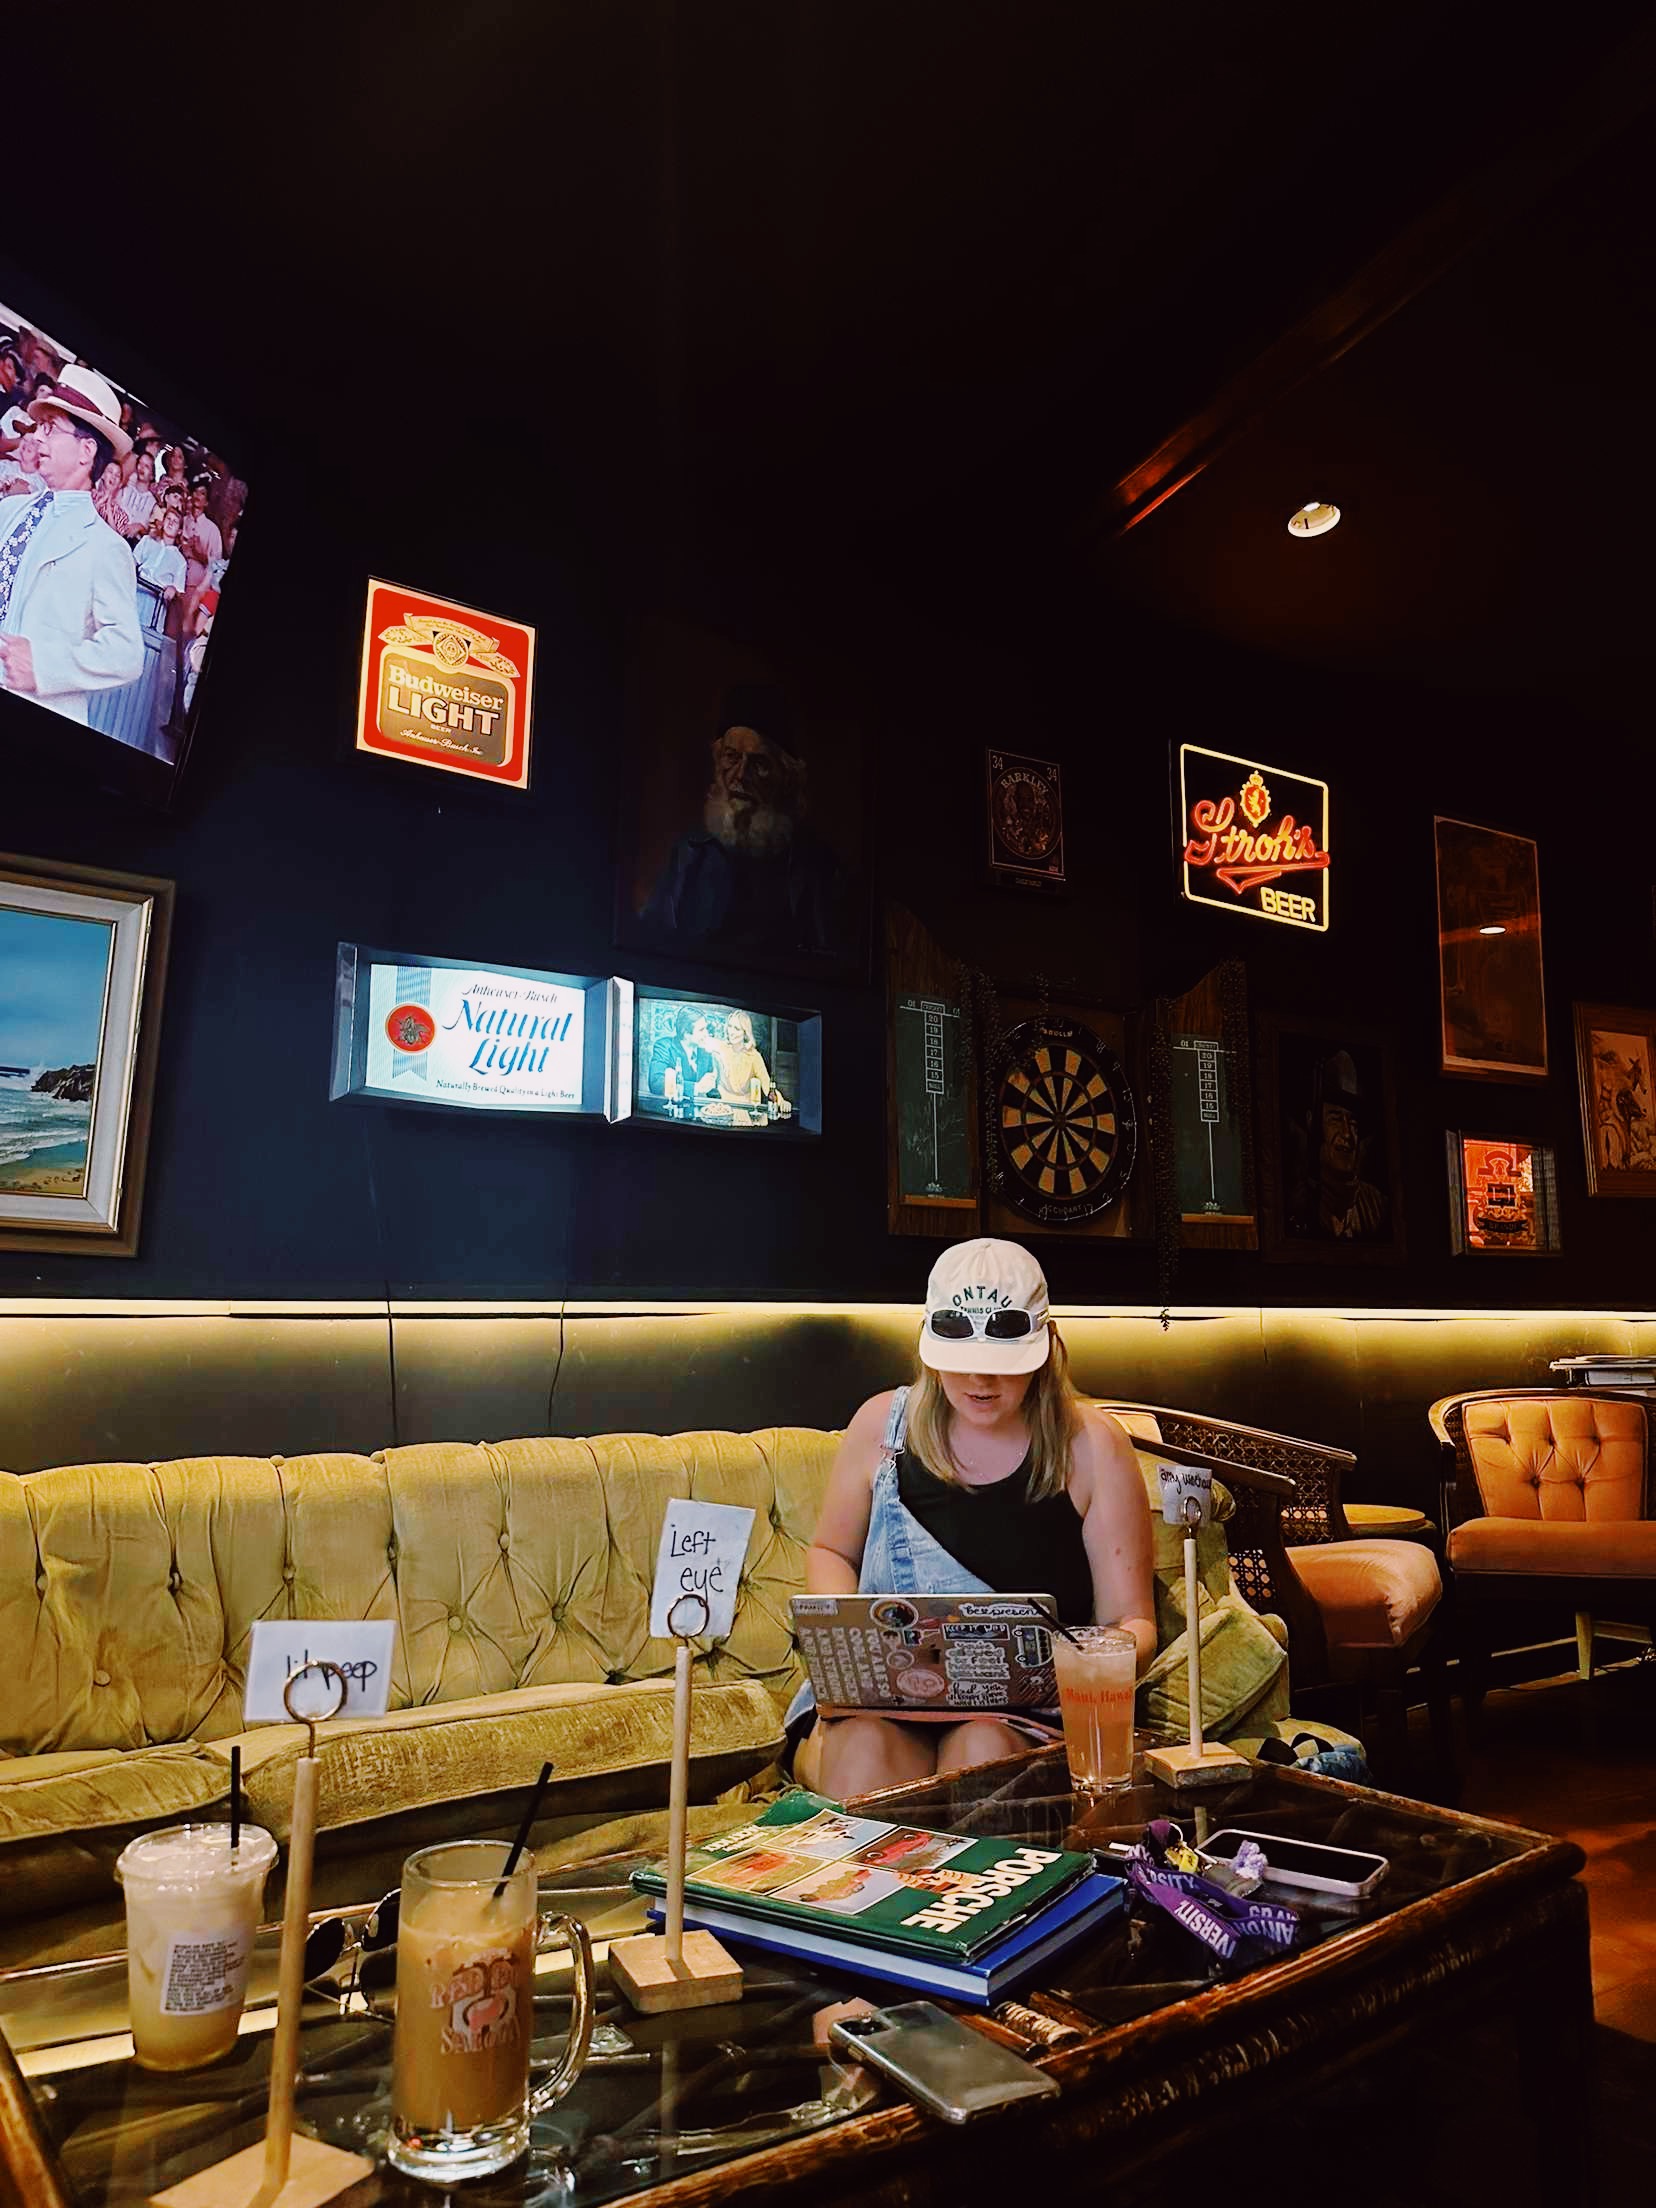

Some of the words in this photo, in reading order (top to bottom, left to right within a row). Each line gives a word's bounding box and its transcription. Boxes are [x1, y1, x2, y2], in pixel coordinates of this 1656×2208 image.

[388, 664, 504, 711] Budweiser
[387, 685, 500, 735] LIGHT
[992, 755, 1003, 771] 34
[1047, 767, 1057, 782] 34
[1184, 797, 1323, 867] Stroh's
[1260, 886, 1316, 923] BEER
[442, 999, 573, 1042] Natural
[928, 1015, 939, 1023] 20
[469, 1038, 550, 1076] Light
[1202, 1052, 1213, 1060] 20
[435, 1079, 472, 1092] Naturally
[472, 1082, 499, 1094] Brewed
[931, 1071, 940, 1080] 15
[952, 1285, 1013, 1308] ONTAU
[1160, 1471, 1182, 1495] amy
[670, 1530, 717, 1557] Left
[680, 1566, 724, 1607] eye
[319, 1660, 378, 1692] peep
[900, 1847, 1063, 1934] PORSCHE
[1173, 1899, 1238, 1960] IVERSITY
